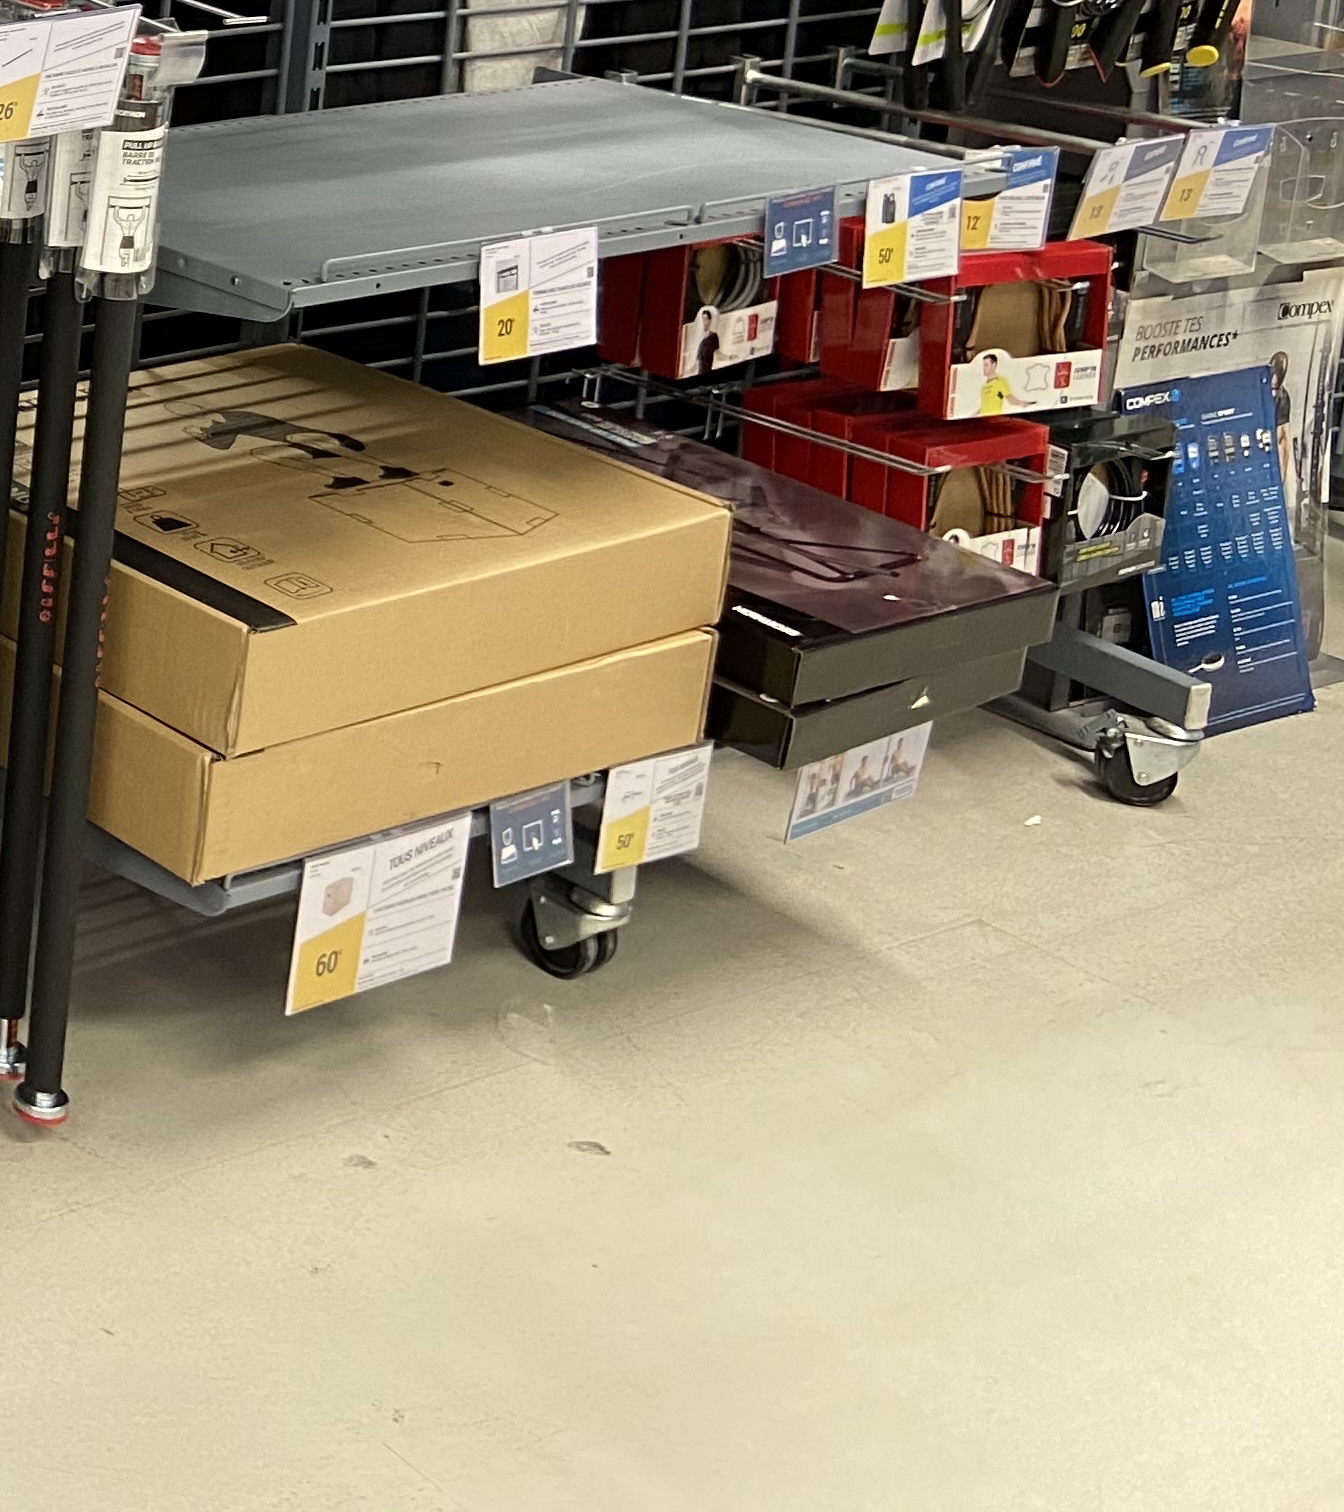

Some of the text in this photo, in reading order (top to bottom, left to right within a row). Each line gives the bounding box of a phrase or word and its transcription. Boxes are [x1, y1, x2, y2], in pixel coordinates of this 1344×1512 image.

[1277, 299, 1334, 321] Compex
[1135, 316, 1204, 342] BOOSTE TES
[1126, 390, 1171, 411] COMPEX
[388, 826, 455, 871] TOUS NIVEAUX
